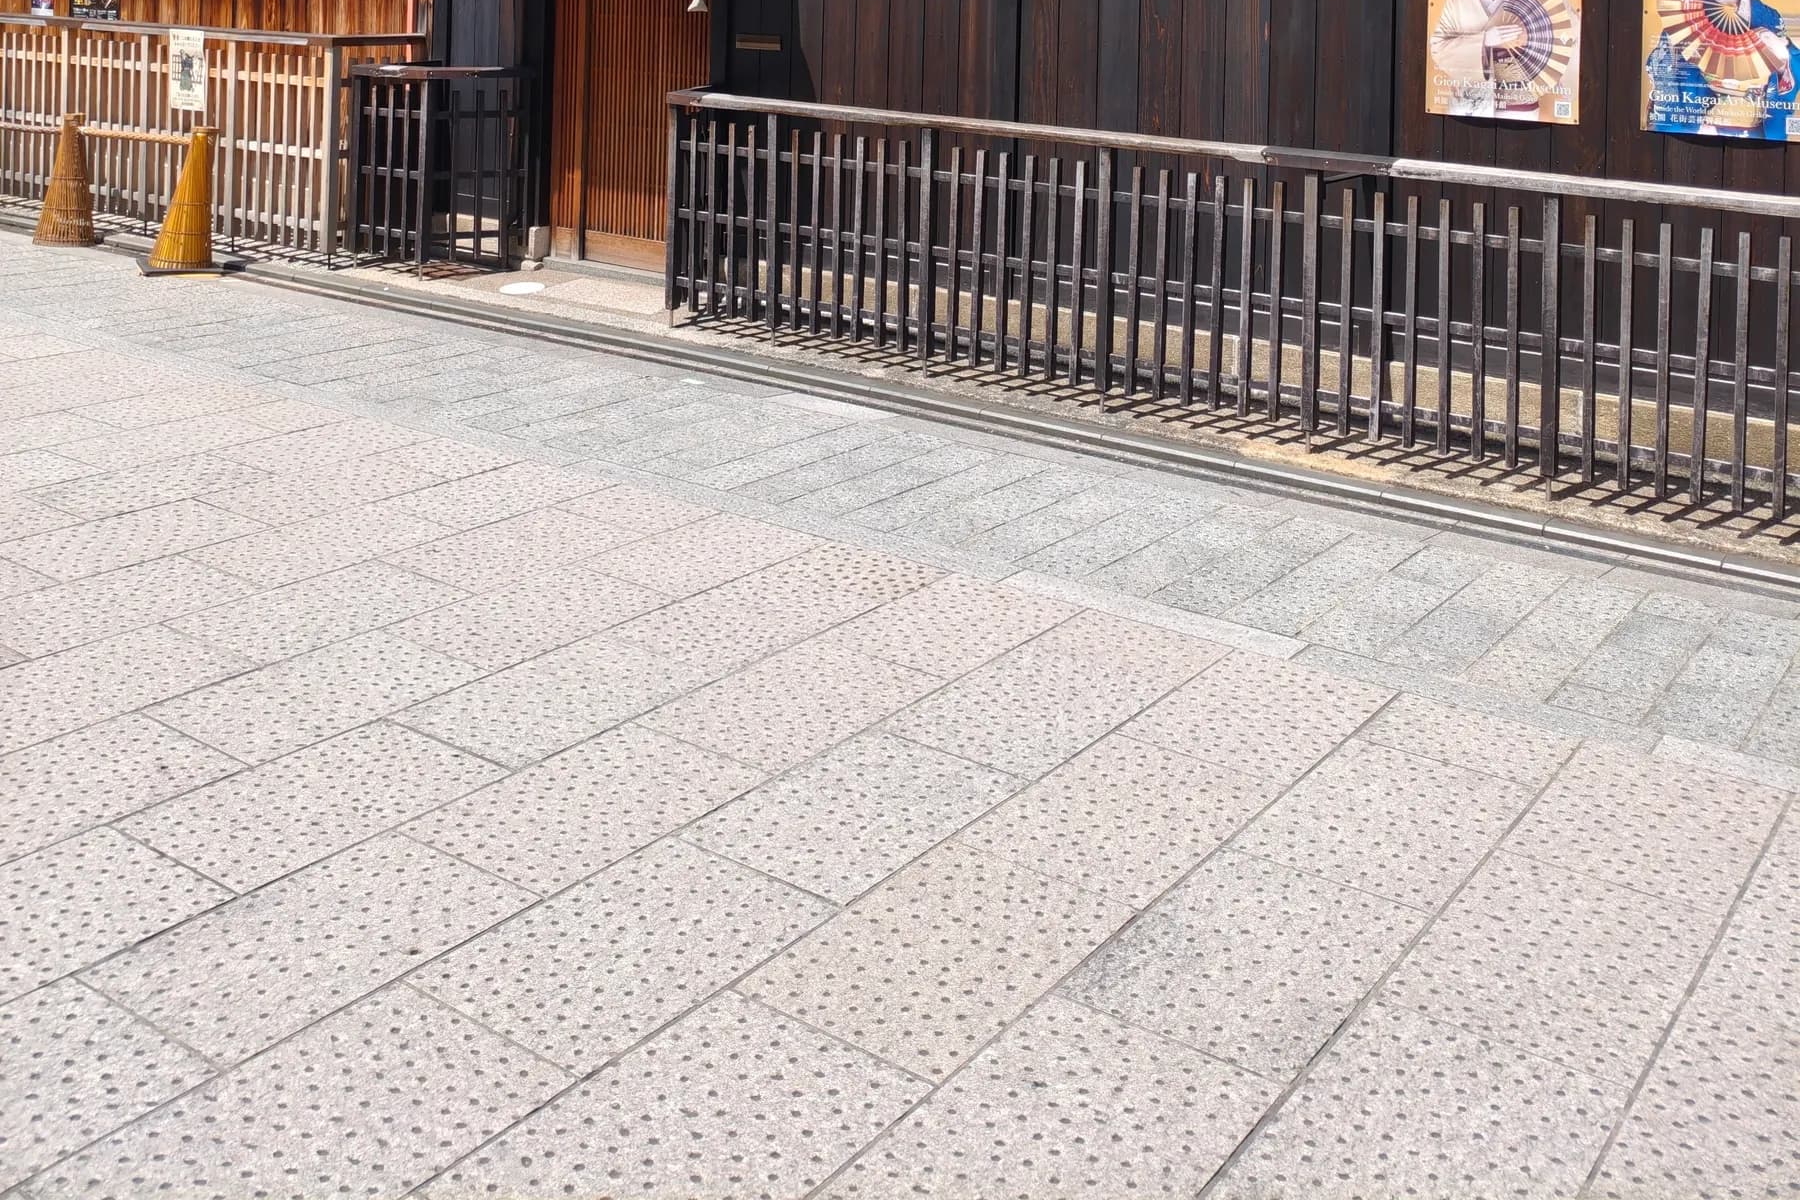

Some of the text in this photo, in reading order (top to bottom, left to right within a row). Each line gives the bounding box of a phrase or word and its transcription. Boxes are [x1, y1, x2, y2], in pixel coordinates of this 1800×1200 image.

[1433, 75, 1572, 95] Gion Kagai Art Museum
[1649, 89, 1680, 103] Gion
[1682, 91, 1721, 108] Kagai
[1723, 94, 1749, 105] Art
[1686, 106, 1706, 114] World
